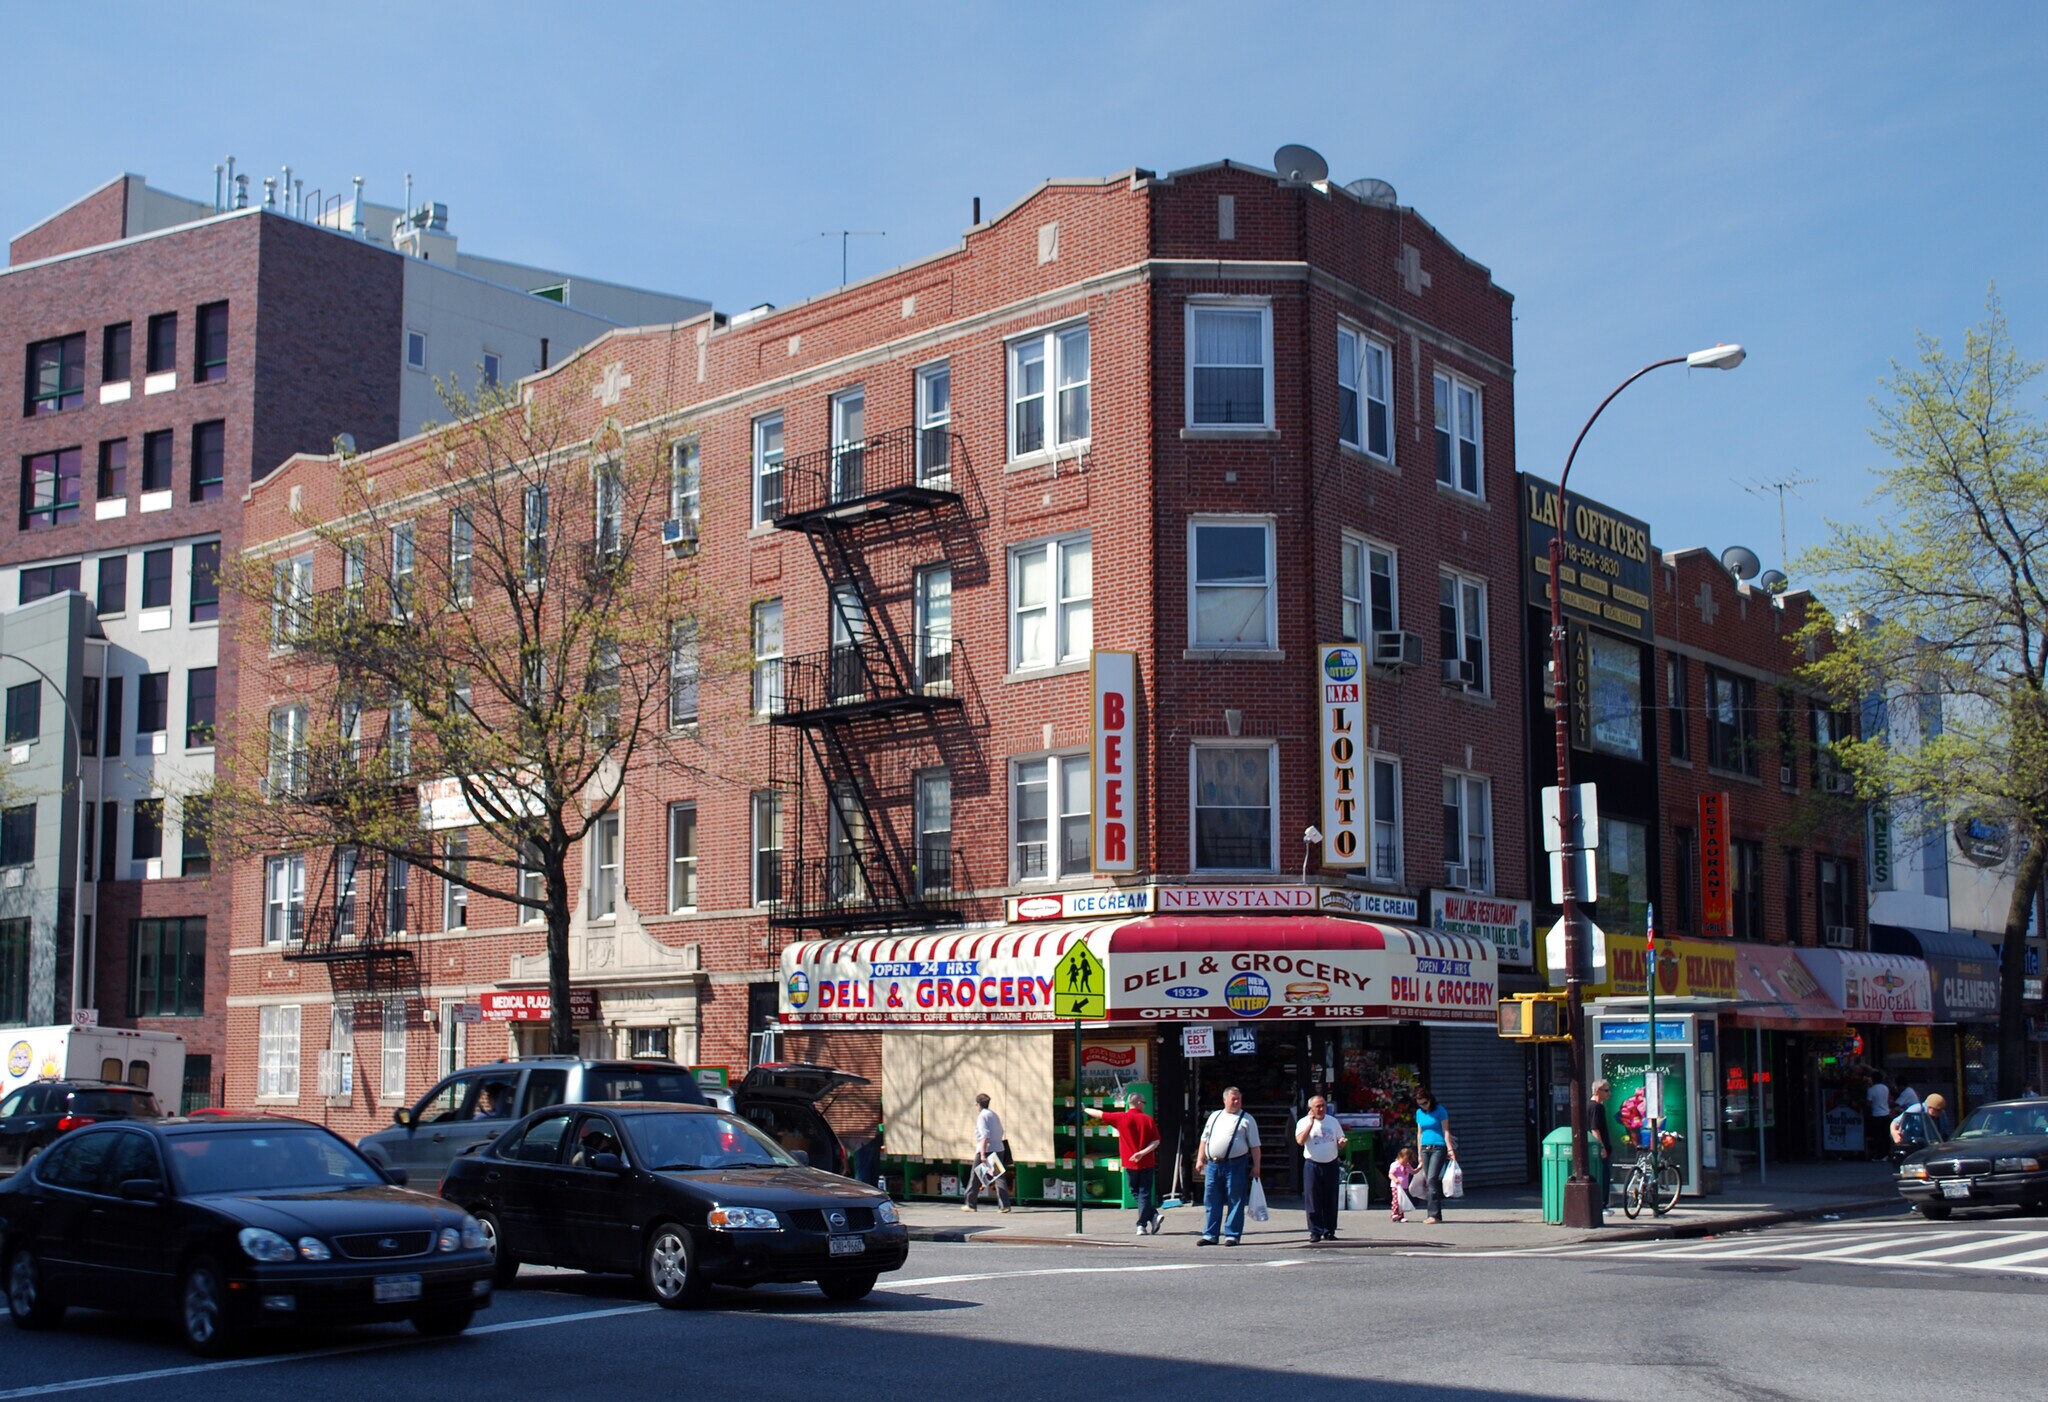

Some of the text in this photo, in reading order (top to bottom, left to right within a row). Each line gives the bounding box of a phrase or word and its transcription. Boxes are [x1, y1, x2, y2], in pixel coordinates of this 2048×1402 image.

[1529, 485, 1646, 563] LAW OFFICES
[1563, 541, 1620, 578] 718-554-3630
[1327, 667, 1357, 677] LOTTERY
[1327, 685, 1357, 702] N.Y.S.
[1103, 692, 1126, 861] BEER
[1331, 707, 1357, 858] LOTTO
[1705, 796, 1720, 898] RESTAURANT
[1073, 893, 1147, 911] ICE CREAM
[1164, 890, 1313, 907] NEWSTAND
[1365, 896, 1380, 912] ICE
[1384, 899, 1415, 917] CREAM
[1477, 901, 1517, 926] RESTAURANT
[1491, 927, 1506, 945] TAKE
[1507, 928, 1517, 946] OUT
[875, 962, 972, 976] OPEN 24 HRS
[1124, 953, 1371, 992] DELI & GROCERY
[1419, 960, 1468, 975] OPEN 24 HRS
[1686, 955, 1735, 989] HEAVEN
[1248, 977, 1264, 985] NEW
[818, 980, 874, 1008] DELI
[887, 982, 903, 1008] &
[916, 976, 1054, 1008] GROCERY
[1173, 988, 1200, 997] 1932
[1248, 985, 1269, 996] YORK
[1391, 975, 1494, 1006] DELI & GROCERY
[1862, 977, 1917, 1010] GROCERY
[1943, 977, 1997, 1009] CLEANERS
[492, 995, 526, 1009] MEDICAL
[1229, 997, 1268, 1010] LOTTERY
[809, 1013, 824, 1021] SODA
[828, 1013, 843, 1021] BEER
[845, 1013, 858, 1021] HOT
[866, 1013, 883, 1021] COLD
[884, 1013, 921, 1021] SANDWICHES
[923, 1012, 947, 1021] COFFEE
[951, 1012, 987, 1021] NEWSPAPER
[990, 1012, 1021, 1021] MAGAZINE
[1025, 1012, 1055, 1020] FLOWERS
[1139, 1006, 1364, 1018] OPEN 24 HRS
[1187, 1035, 1206, 1045] EBT
[1229, 1028, 1255, 1041] MILK
[1617, 1064, 1670, 1075] KINGS PAZA
